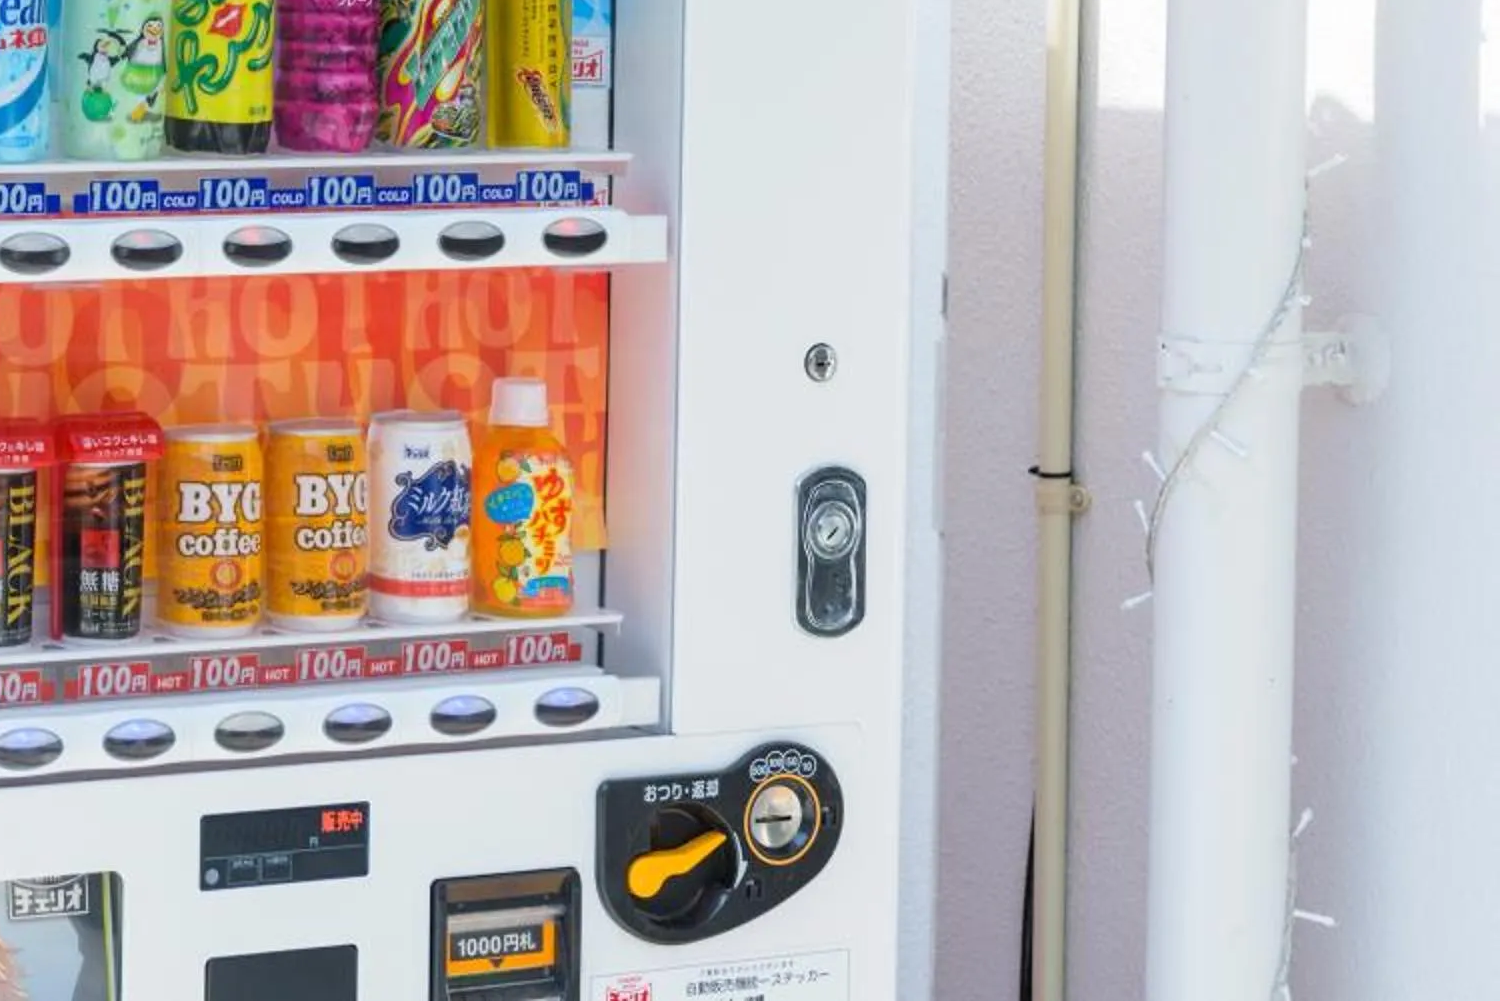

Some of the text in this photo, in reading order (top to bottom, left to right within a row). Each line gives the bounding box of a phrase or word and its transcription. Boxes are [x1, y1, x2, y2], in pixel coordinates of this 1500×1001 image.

[91, 181, 157, 211] 100円
[202, 179, 265, 208] 100円
[271, 192, 305, 205] COLD
[310, 177, 372, 205] 100円
[378, 189, 409, 202] COLD
[415, 174, 477, 203] 100円
[483, 187, 514, 200] COLD
[518, 172, 579, 200] 100円
[163, 195, 196, 208] COLD
[79, 570, 119, 592] 無糖
[403, 643, 465, 672] 100円
[473, 653, 499, 666] HOT
[507, 635, 569, 663] 100円
[192, 658, 256, 688] 100円
[264, 668, 290, 681] HOT
[299, 650, 361, 680] 100円
[370, 660, 397, 674] HOT
[81, 665, 148, 696] 100円
[156, 675, 182, 689] HOT
[643, 779, 719, 802] おつり・返却
[322, 809, 364, 834] 販売中
[14, 882, 84, 915] チェリオ
[456, 931, 536, 958] 1000円札
